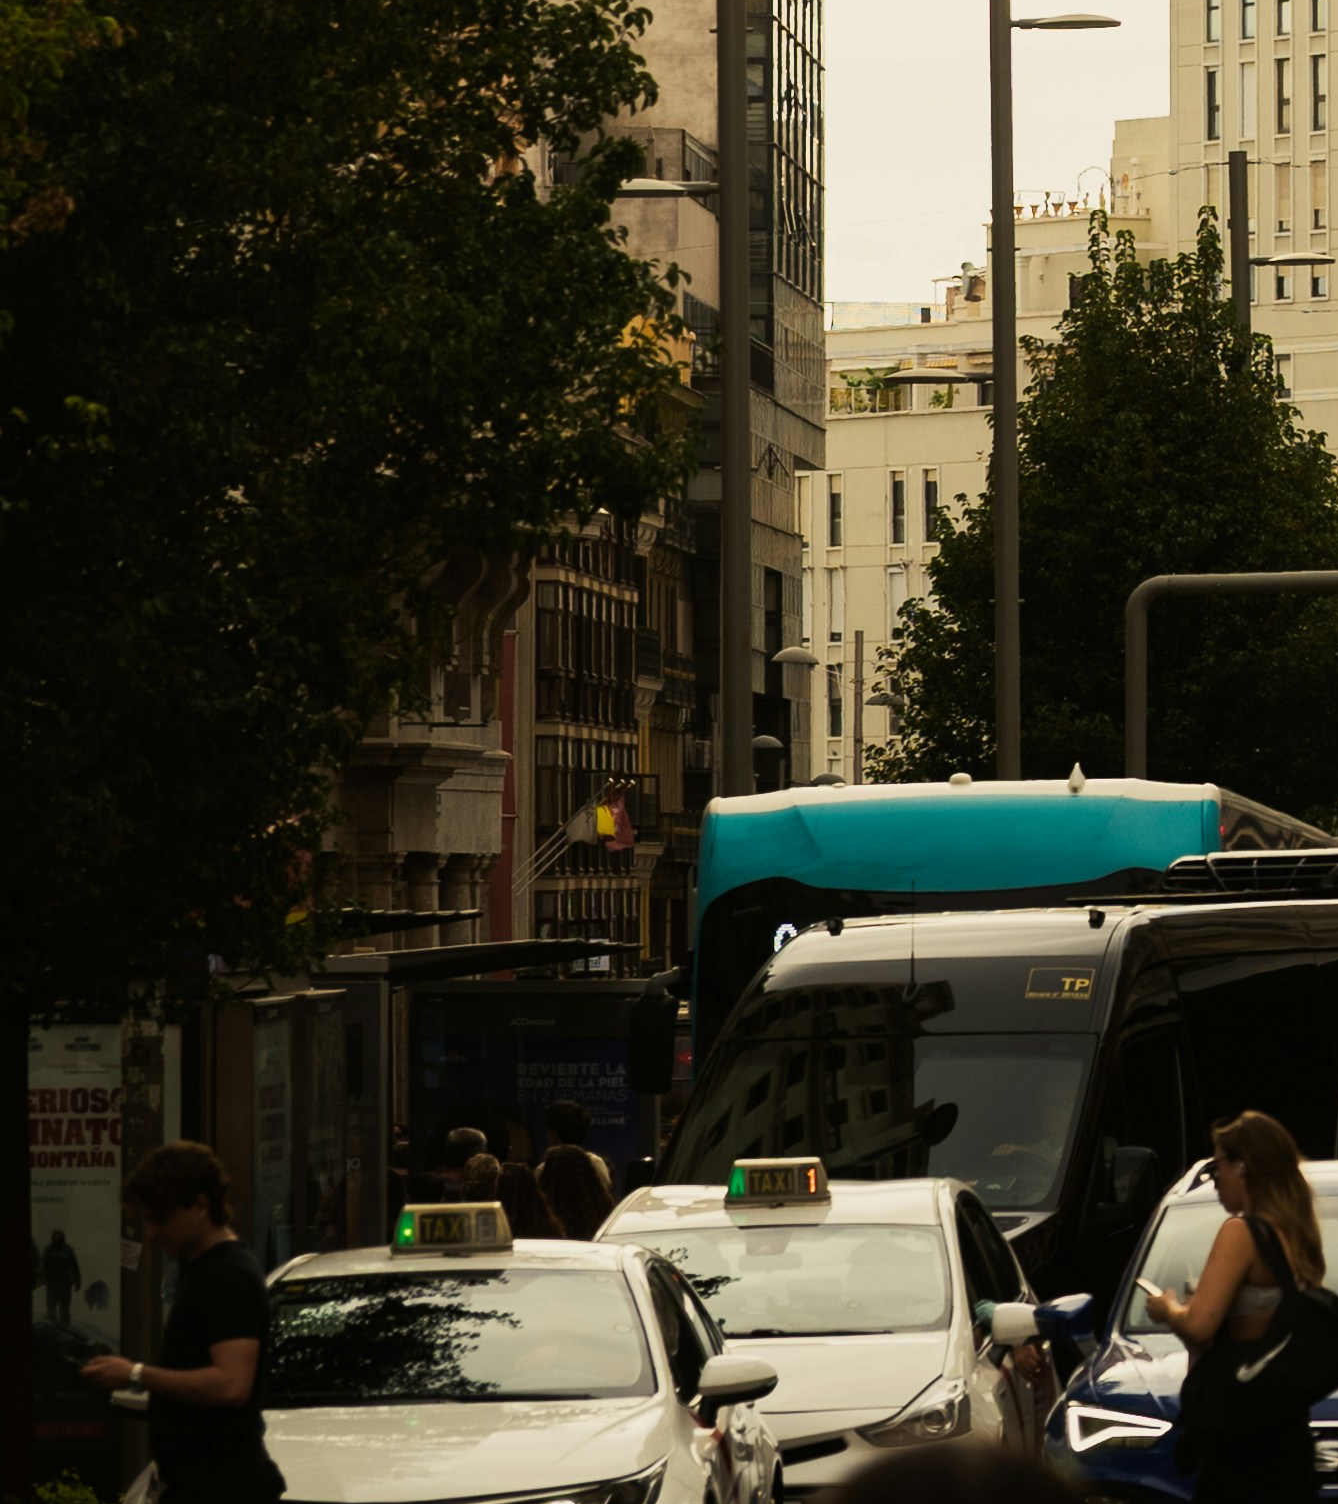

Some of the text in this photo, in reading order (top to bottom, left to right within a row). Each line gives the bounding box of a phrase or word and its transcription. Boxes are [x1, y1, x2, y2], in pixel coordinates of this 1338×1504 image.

[1061, 977, 1089, 991] TP
[517, 1063, 627, 1075] REVIERTE LA
[517, 1077, 626, 1087] EDAD DE LA PIEL
[517, 1090, 537, 1102] EN
[542, 1090, 549, 1101] 2
[751, 1168, 816, 1194] TAXI 1
[421, 1217, 470, 1242] TAXI
